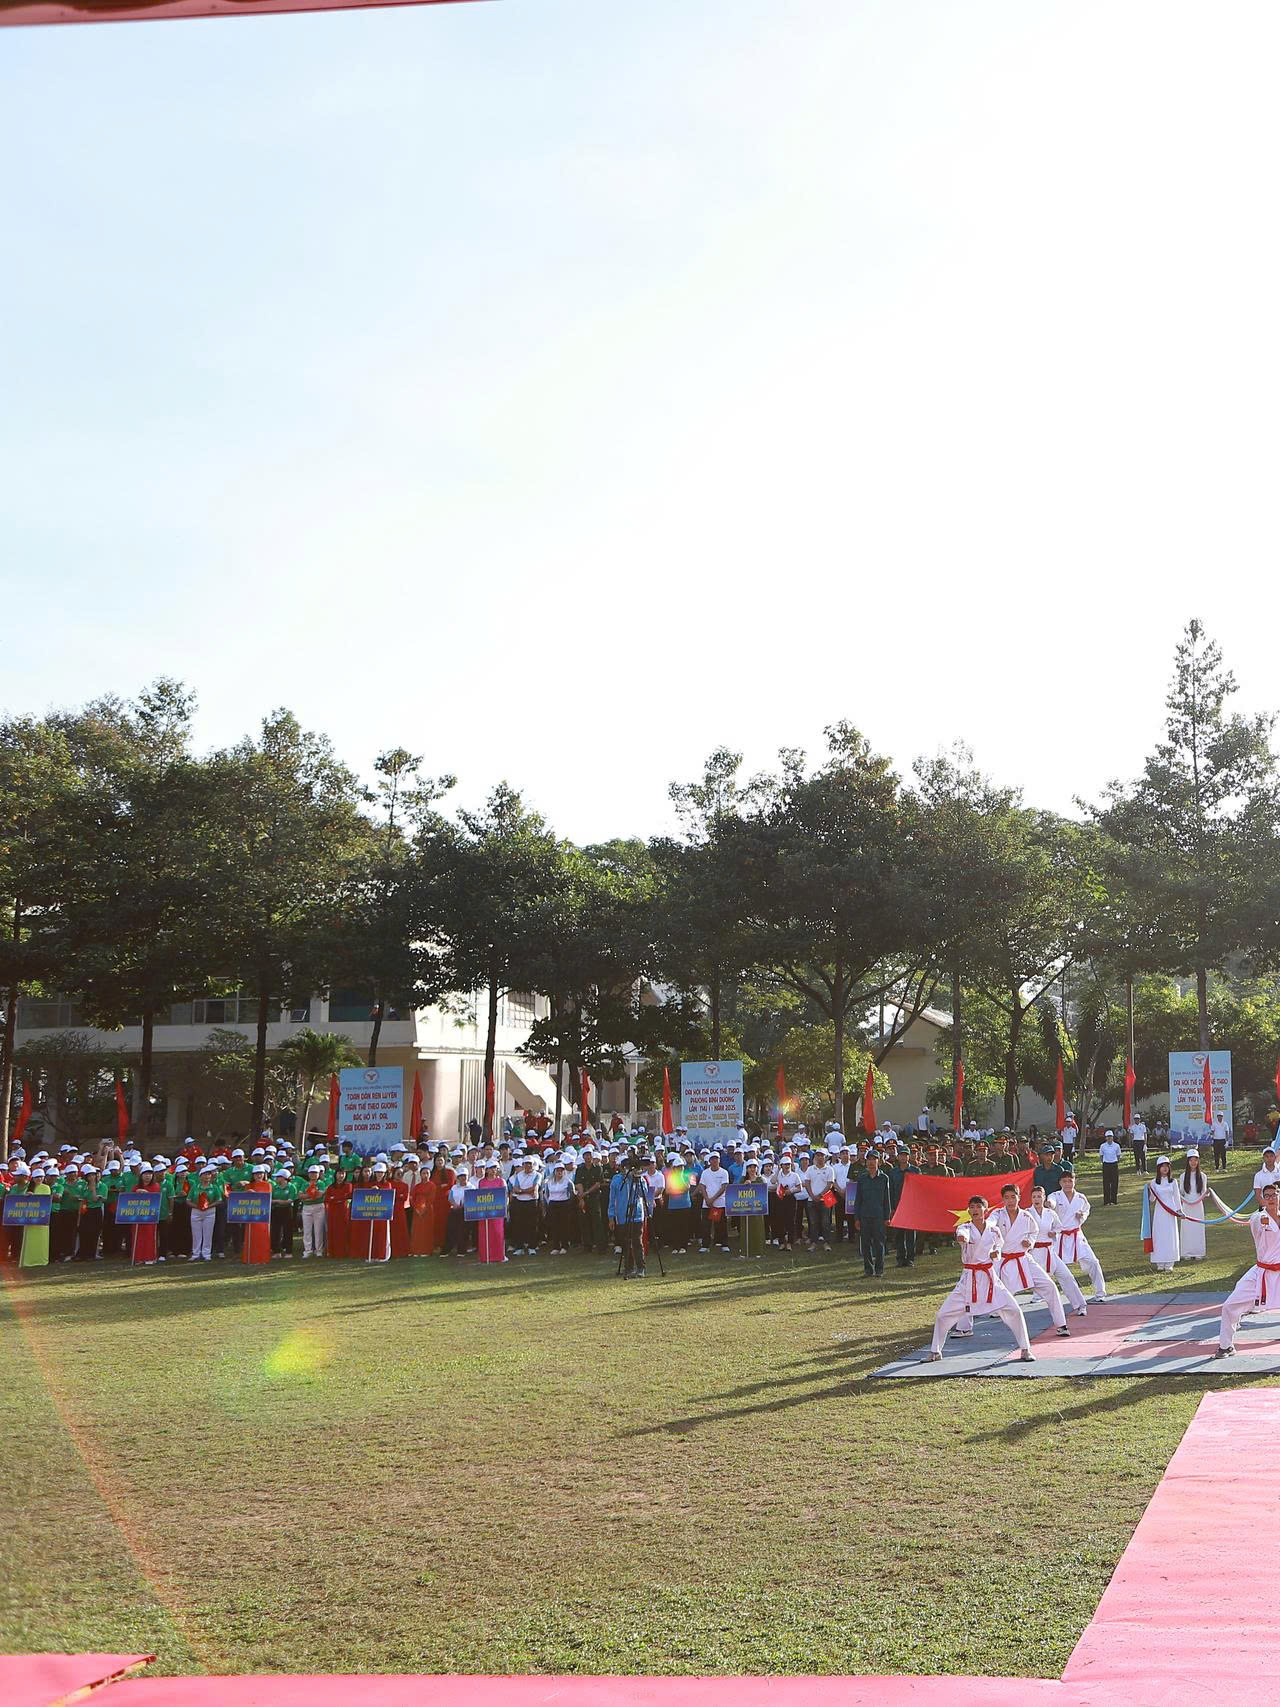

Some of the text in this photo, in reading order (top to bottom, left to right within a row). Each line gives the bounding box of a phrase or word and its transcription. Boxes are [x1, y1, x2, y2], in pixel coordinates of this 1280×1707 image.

[365, 1193, 381, 1203] KHỐI
[477, 1193, 494, 1203] KHỐI
[738, 1188, 755, 1198] KHỐI
